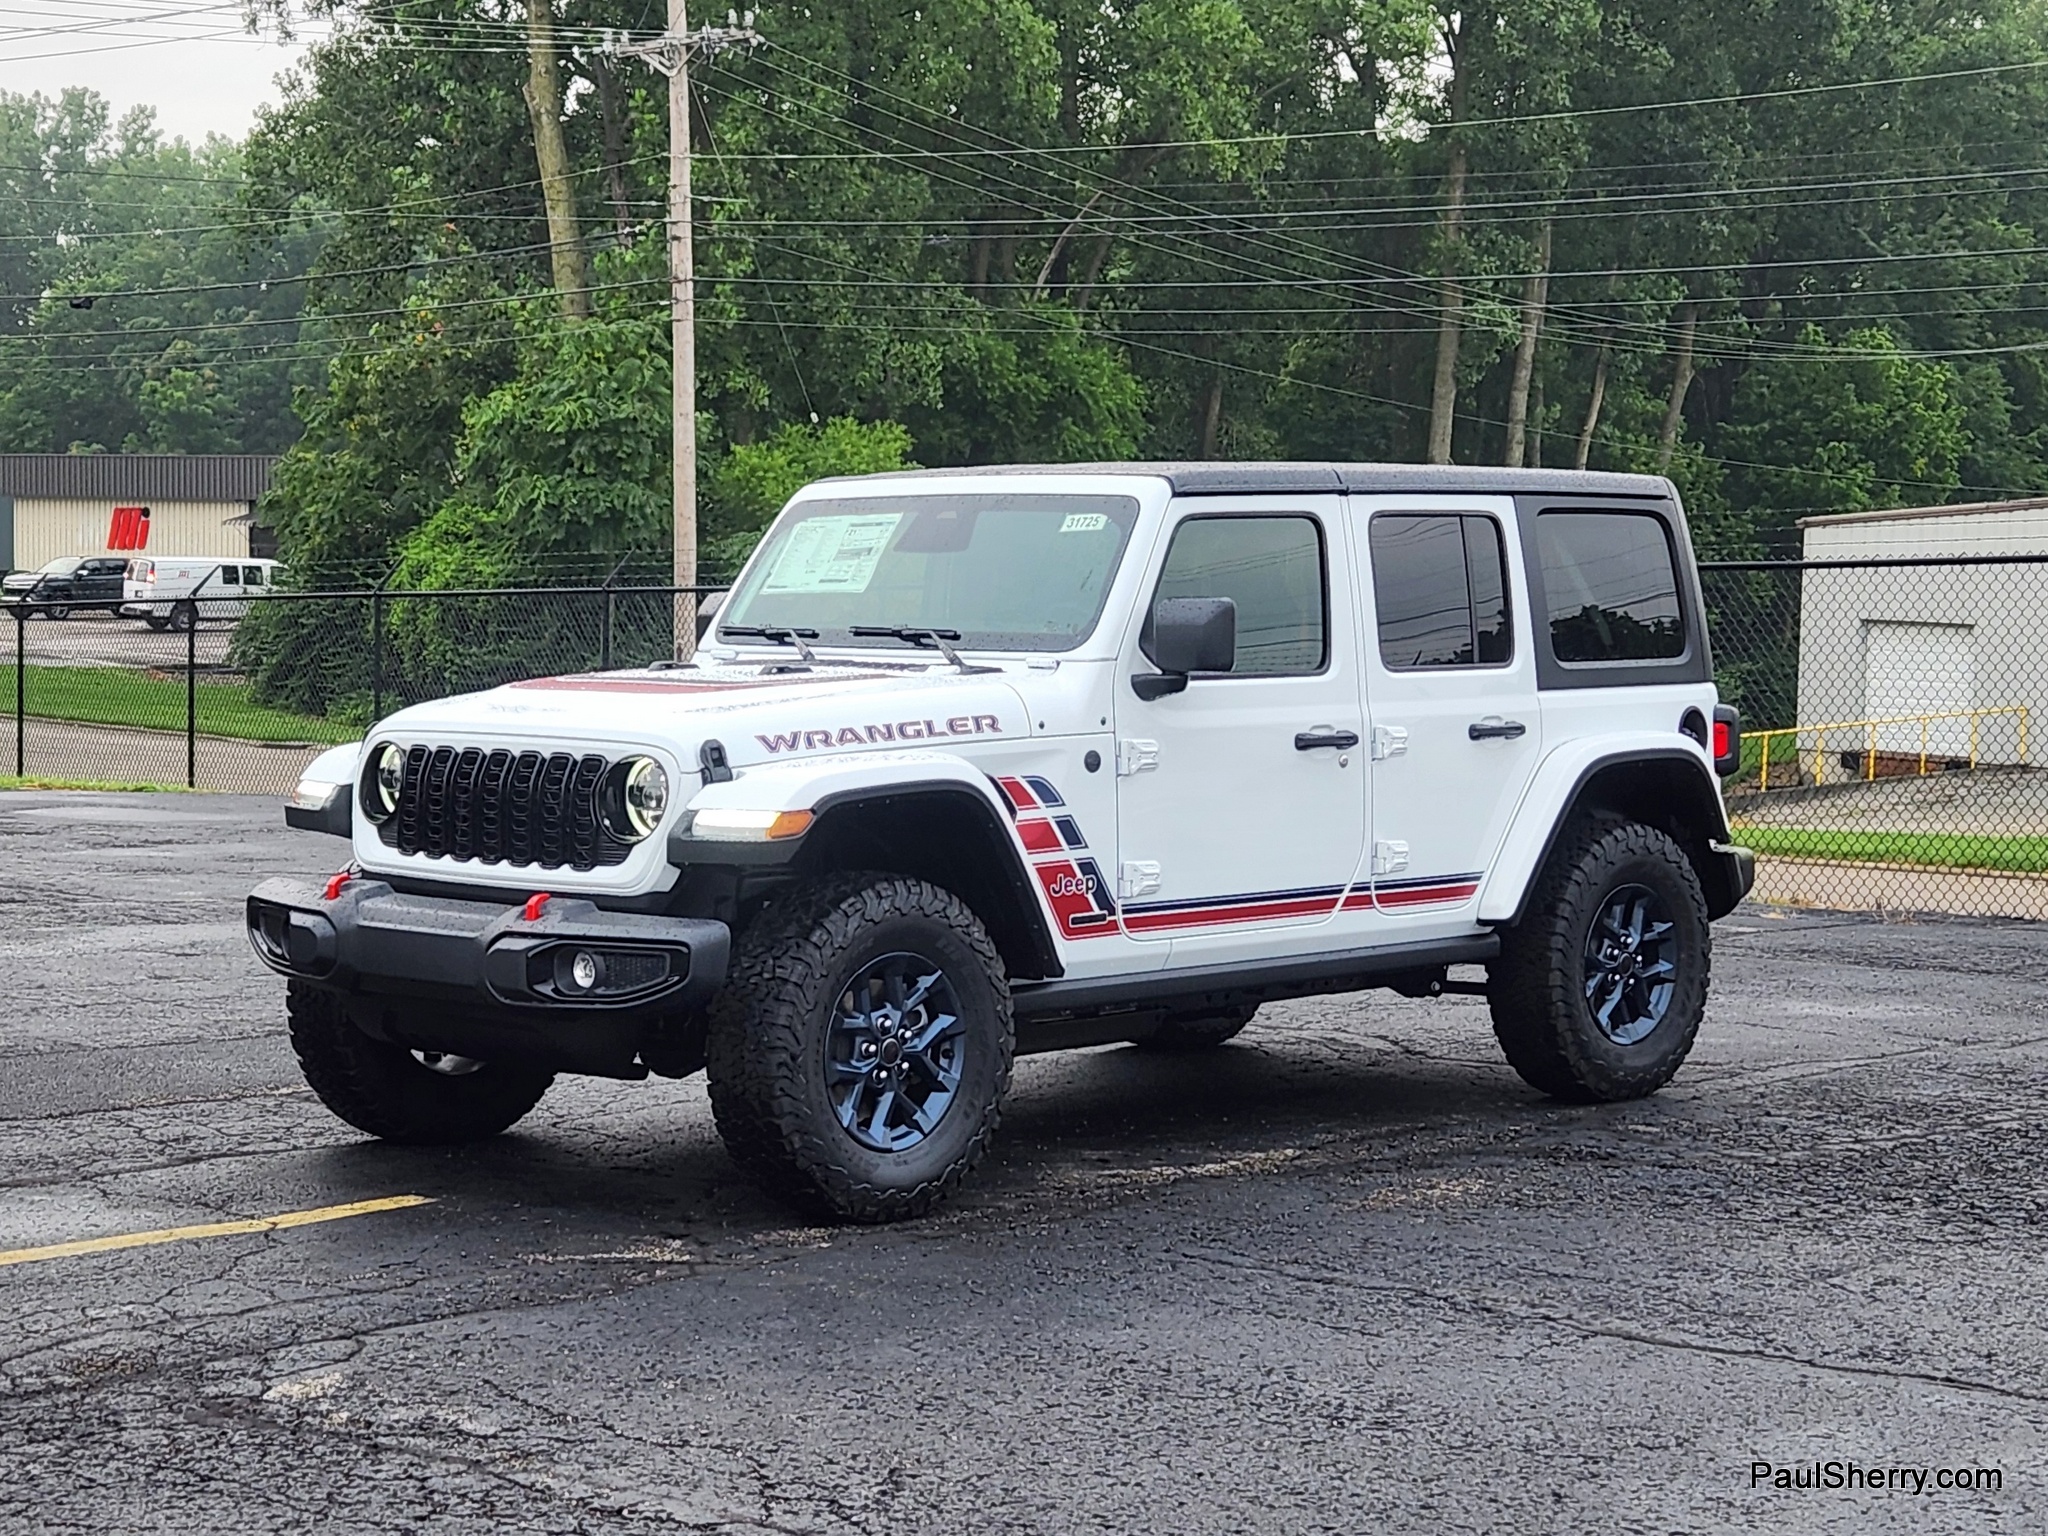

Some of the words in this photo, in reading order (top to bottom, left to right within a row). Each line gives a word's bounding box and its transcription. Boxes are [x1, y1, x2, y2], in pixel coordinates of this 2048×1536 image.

[1066, 516, 1101, 528] 31725
[755, 714, 1002, 753] WRANGLER
[1050, 874, 1096, 896] Jeep
